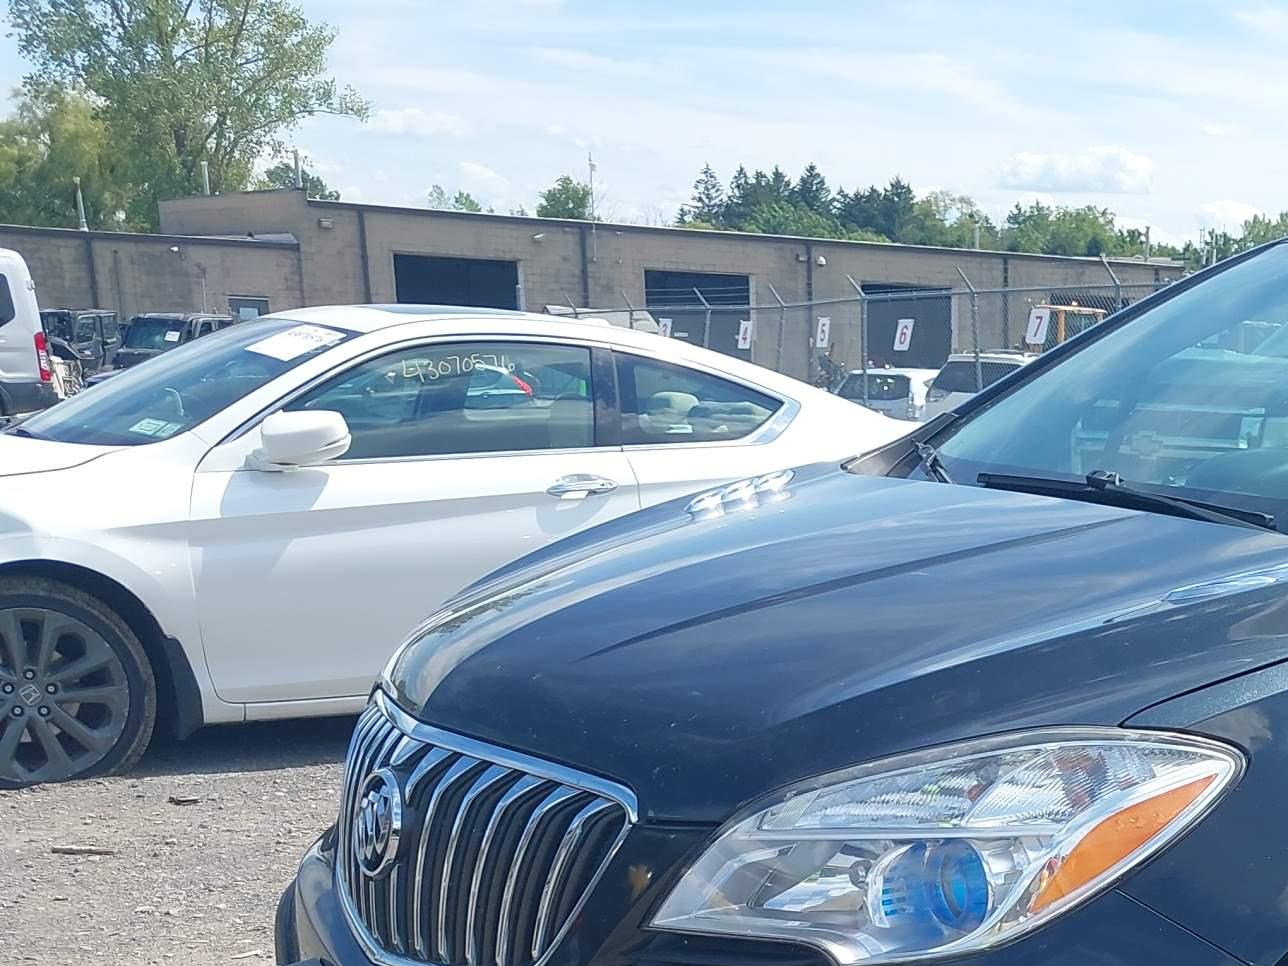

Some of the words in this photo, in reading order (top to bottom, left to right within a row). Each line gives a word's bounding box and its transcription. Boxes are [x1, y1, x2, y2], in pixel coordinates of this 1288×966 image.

[741, 326, 749, 344] 4
[818, 322, 827, 342] 5
[899, 324, 909, 345] 6
[1033, 315, 1044, 338] 7
[402, 353, 516, 383] 43070576
